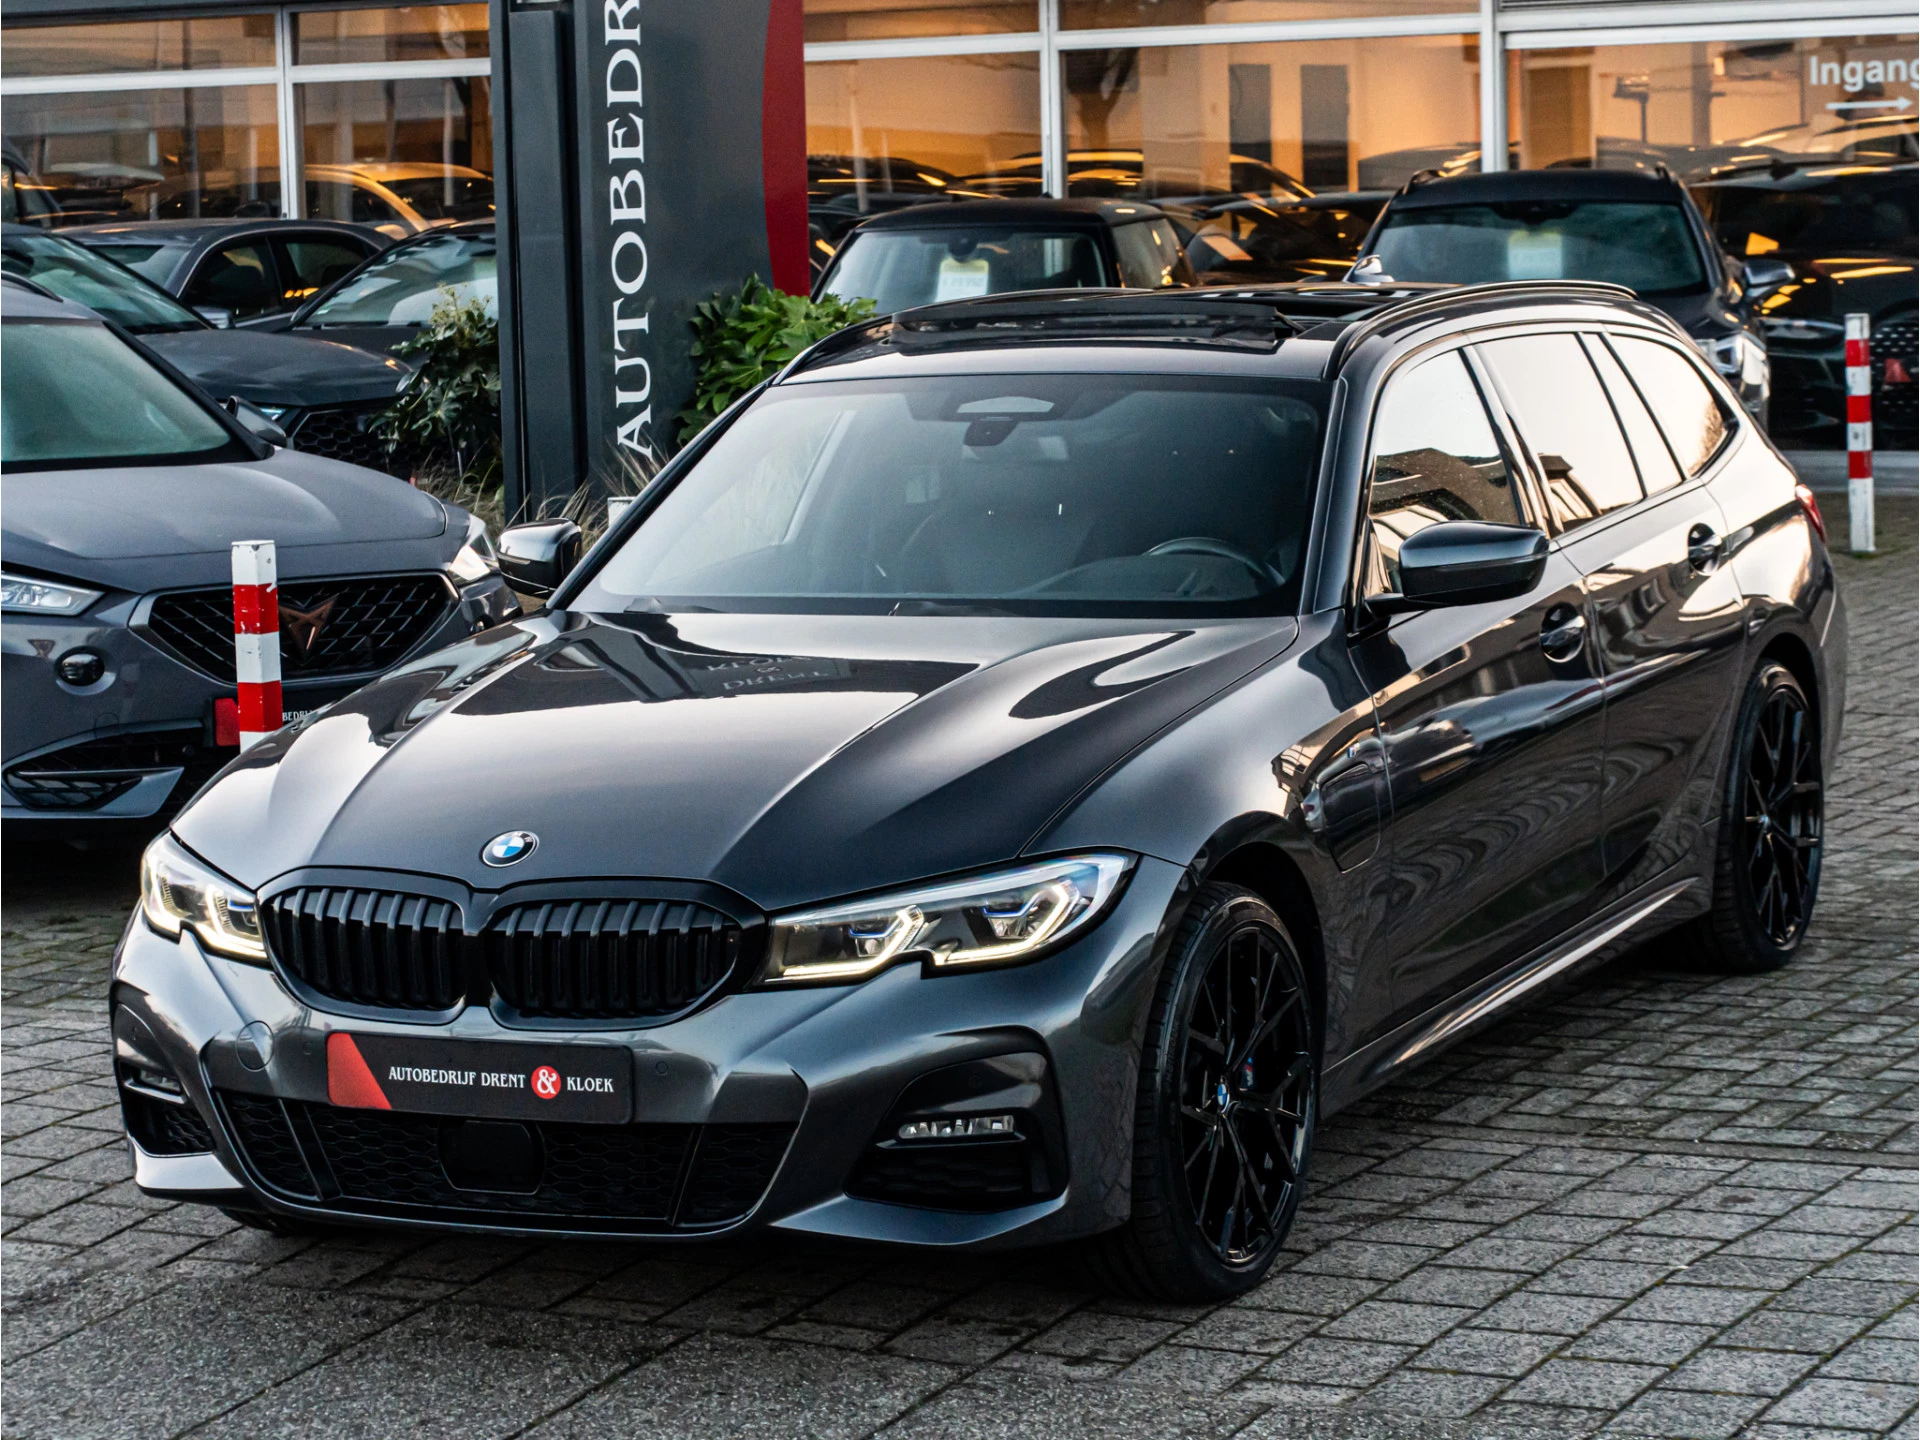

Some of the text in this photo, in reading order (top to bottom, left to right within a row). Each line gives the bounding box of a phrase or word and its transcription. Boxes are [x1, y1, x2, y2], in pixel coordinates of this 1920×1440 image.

[604, 0, 653, 461] AUTOBEDR
[388, 1066, 614, 1094] AUTOBEDRIJF DRENT & KLOEK
